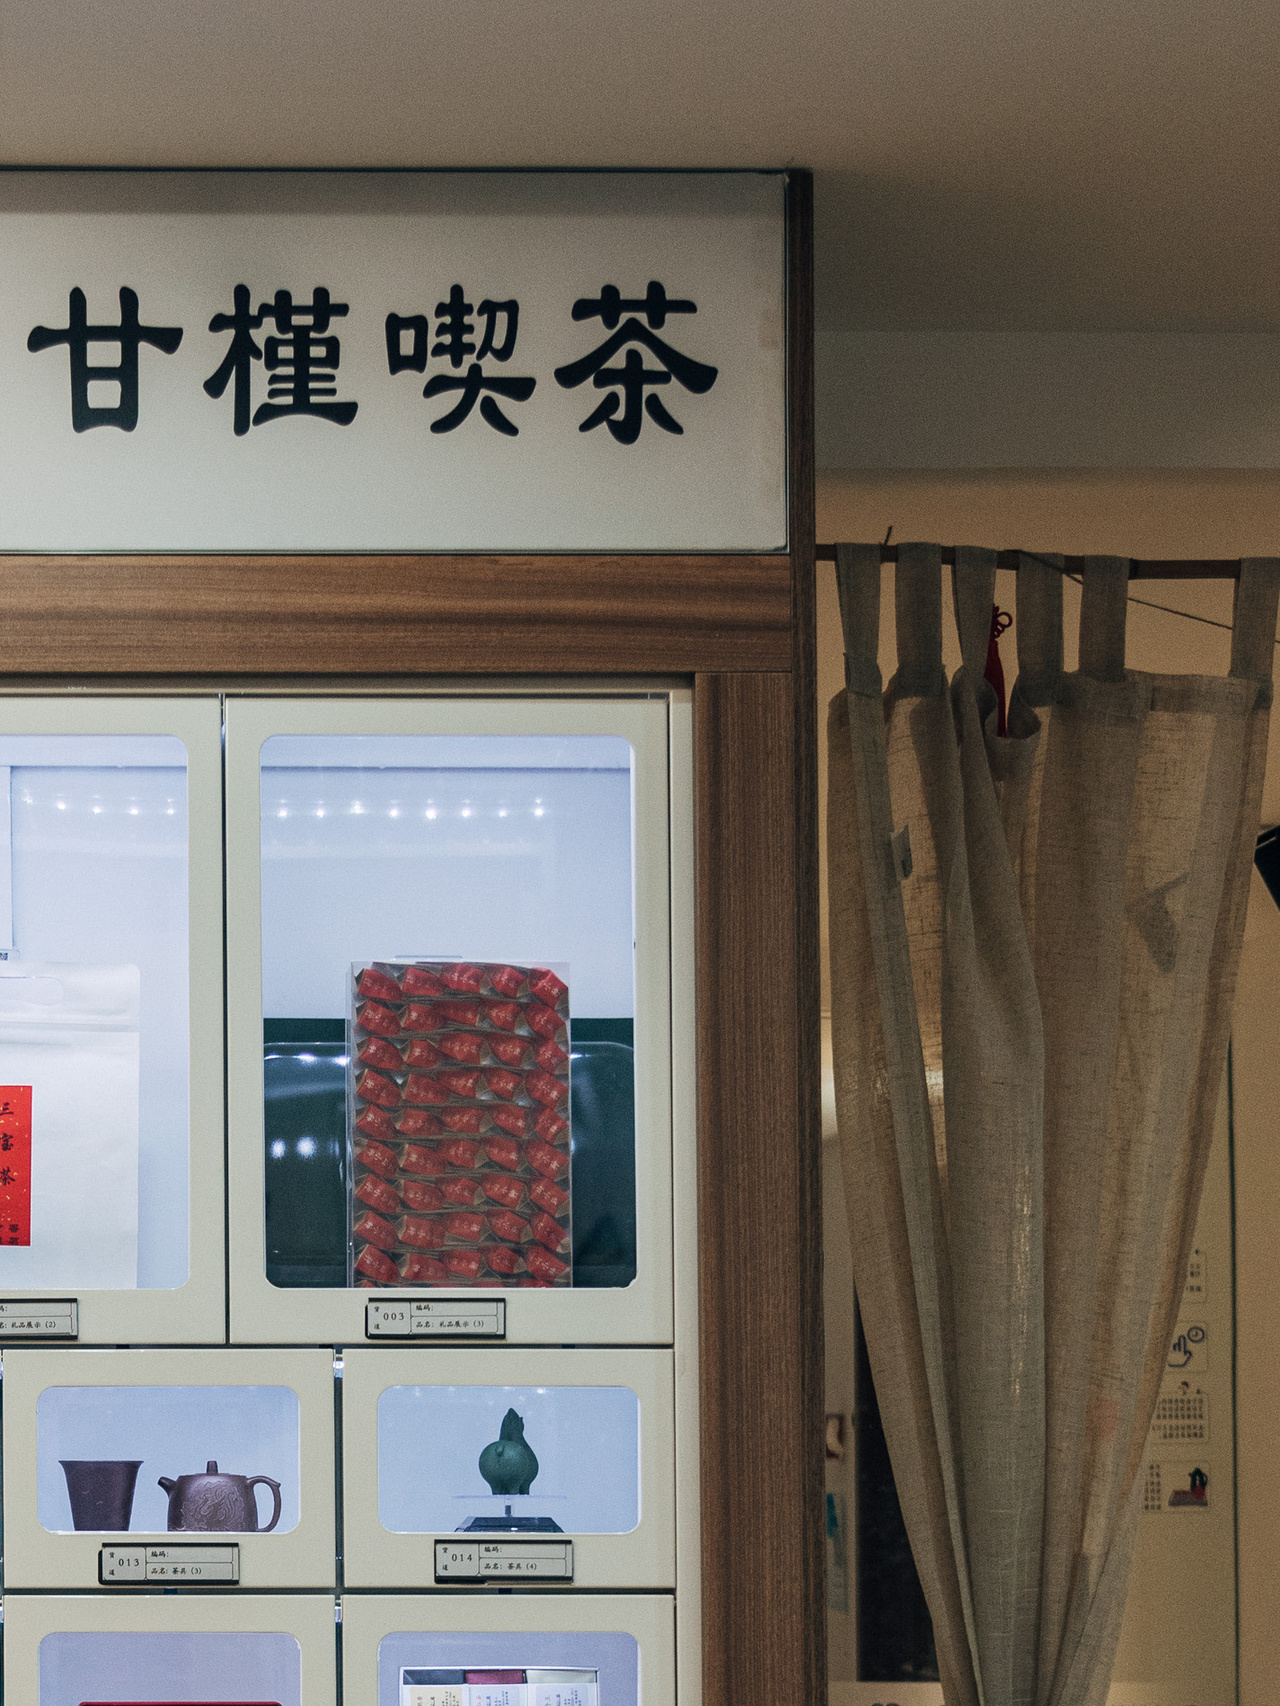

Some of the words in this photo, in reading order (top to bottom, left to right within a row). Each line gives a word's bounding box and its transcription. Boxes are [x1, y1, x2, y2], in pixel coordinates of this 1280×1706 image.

[26, 283, 718, 446] 甘槿喫茶
[383, 1312, 405, 1321] 003
[118, 1557, 140, 1567] 013
[451, 1553, 473, 1562] 014
